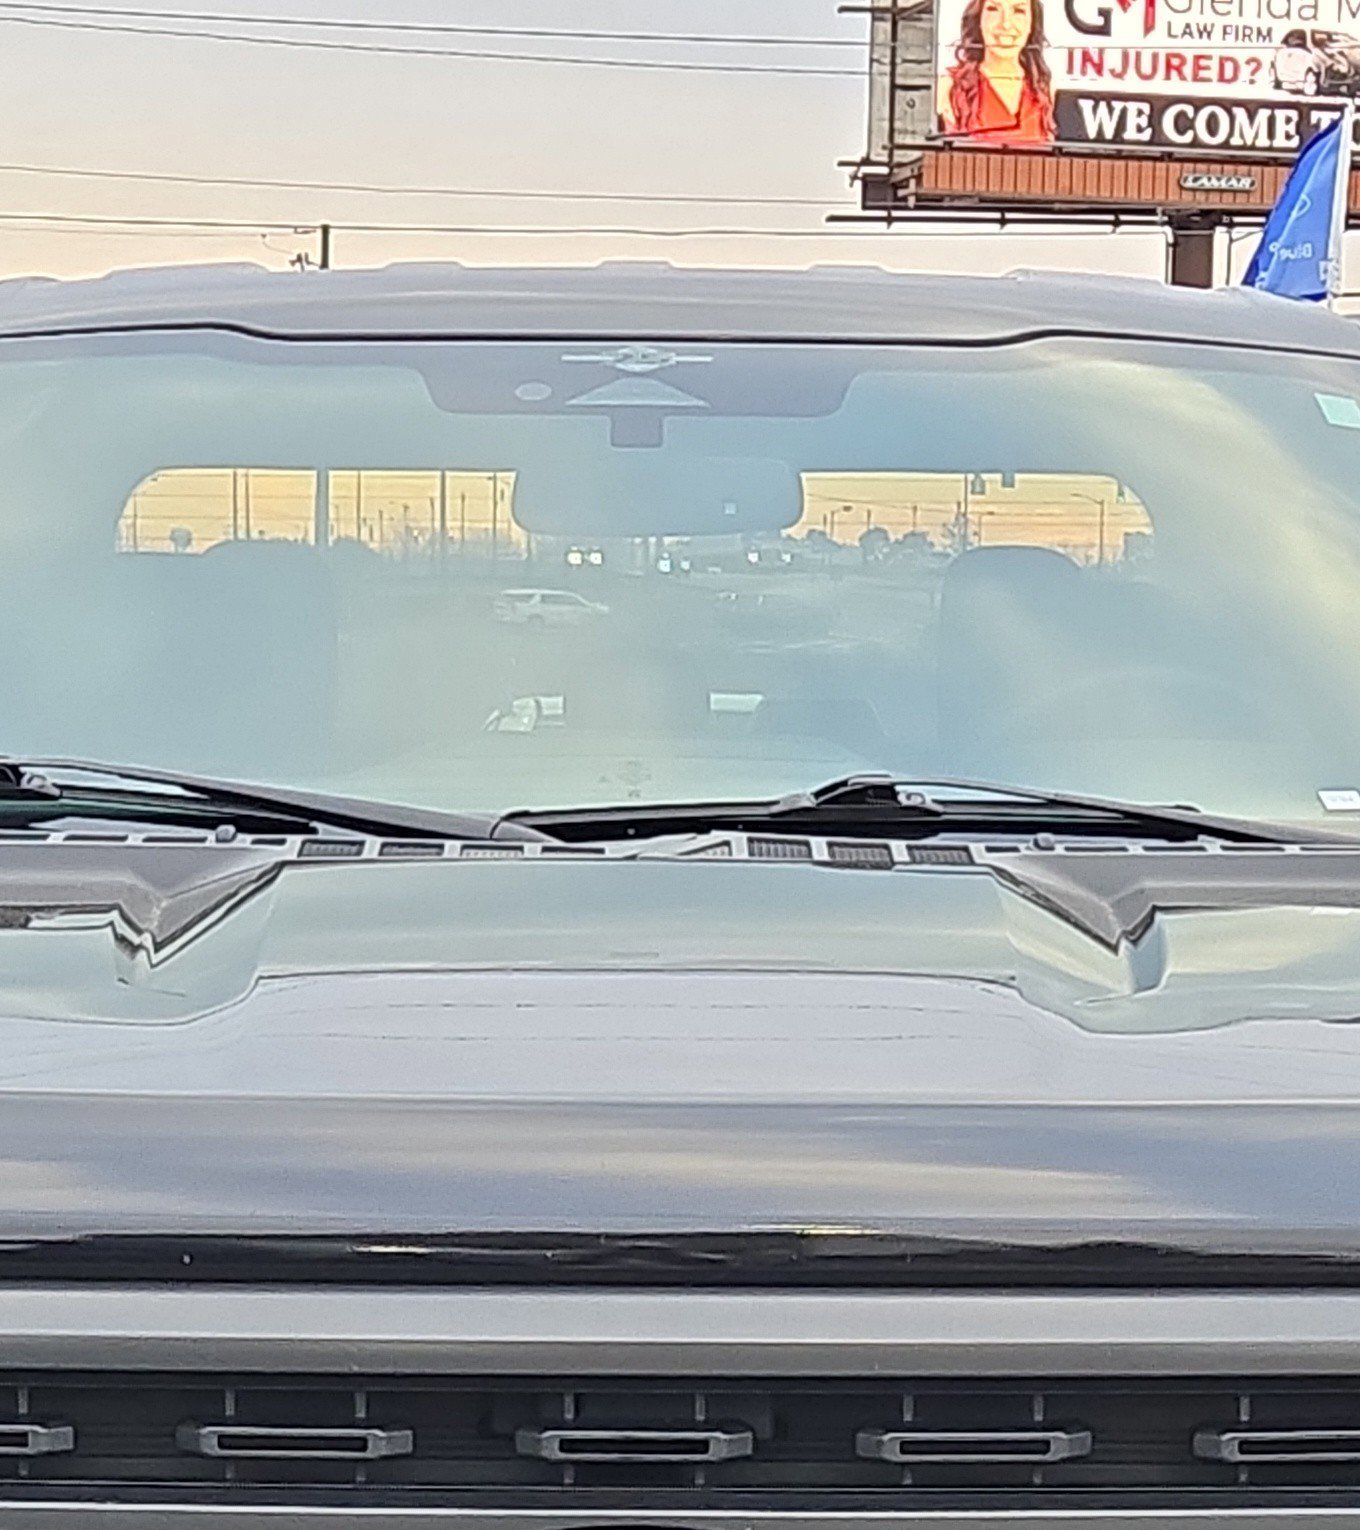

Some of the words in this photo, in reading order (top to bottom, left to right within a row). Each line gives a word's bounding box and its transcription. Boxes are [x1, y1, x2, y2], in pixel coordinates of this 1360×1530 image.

[1167, 20, 1215, 41] LAW
[1222, 24, 1274, 43] FIRM
[1066, 47, 1263, 85] INJURED?
[1077, 98, 1153, 141] WE
[1162, 104, 1300, 148] COME
